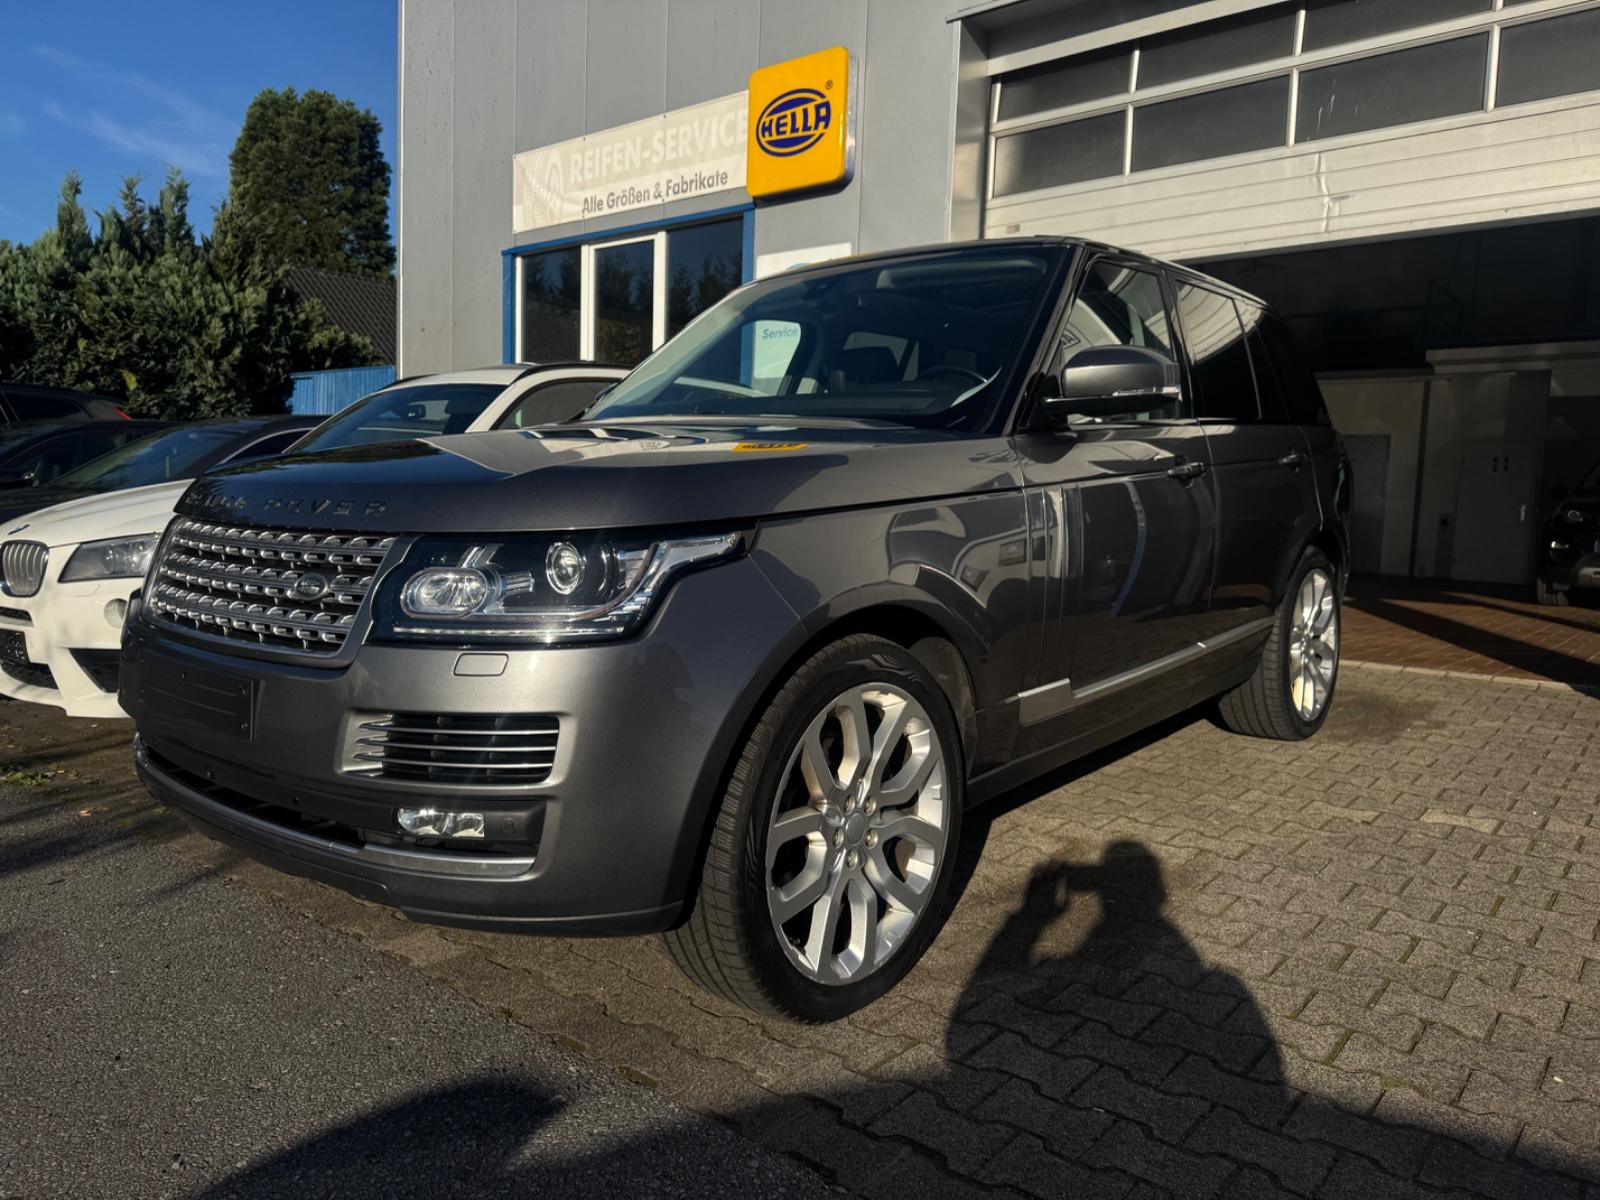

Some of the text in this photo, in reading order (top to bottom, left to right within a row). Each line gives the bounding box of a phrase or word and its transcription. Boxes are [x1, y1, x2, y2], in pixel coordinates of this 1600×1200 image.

[761, 100, 831, 138] HELLA
[570, 110, 748, 183] REIFEN-SERVICE
[582, 170, 728, 214] Alle Größen & Fabrikate
[762, 327, 799, 340] Service
